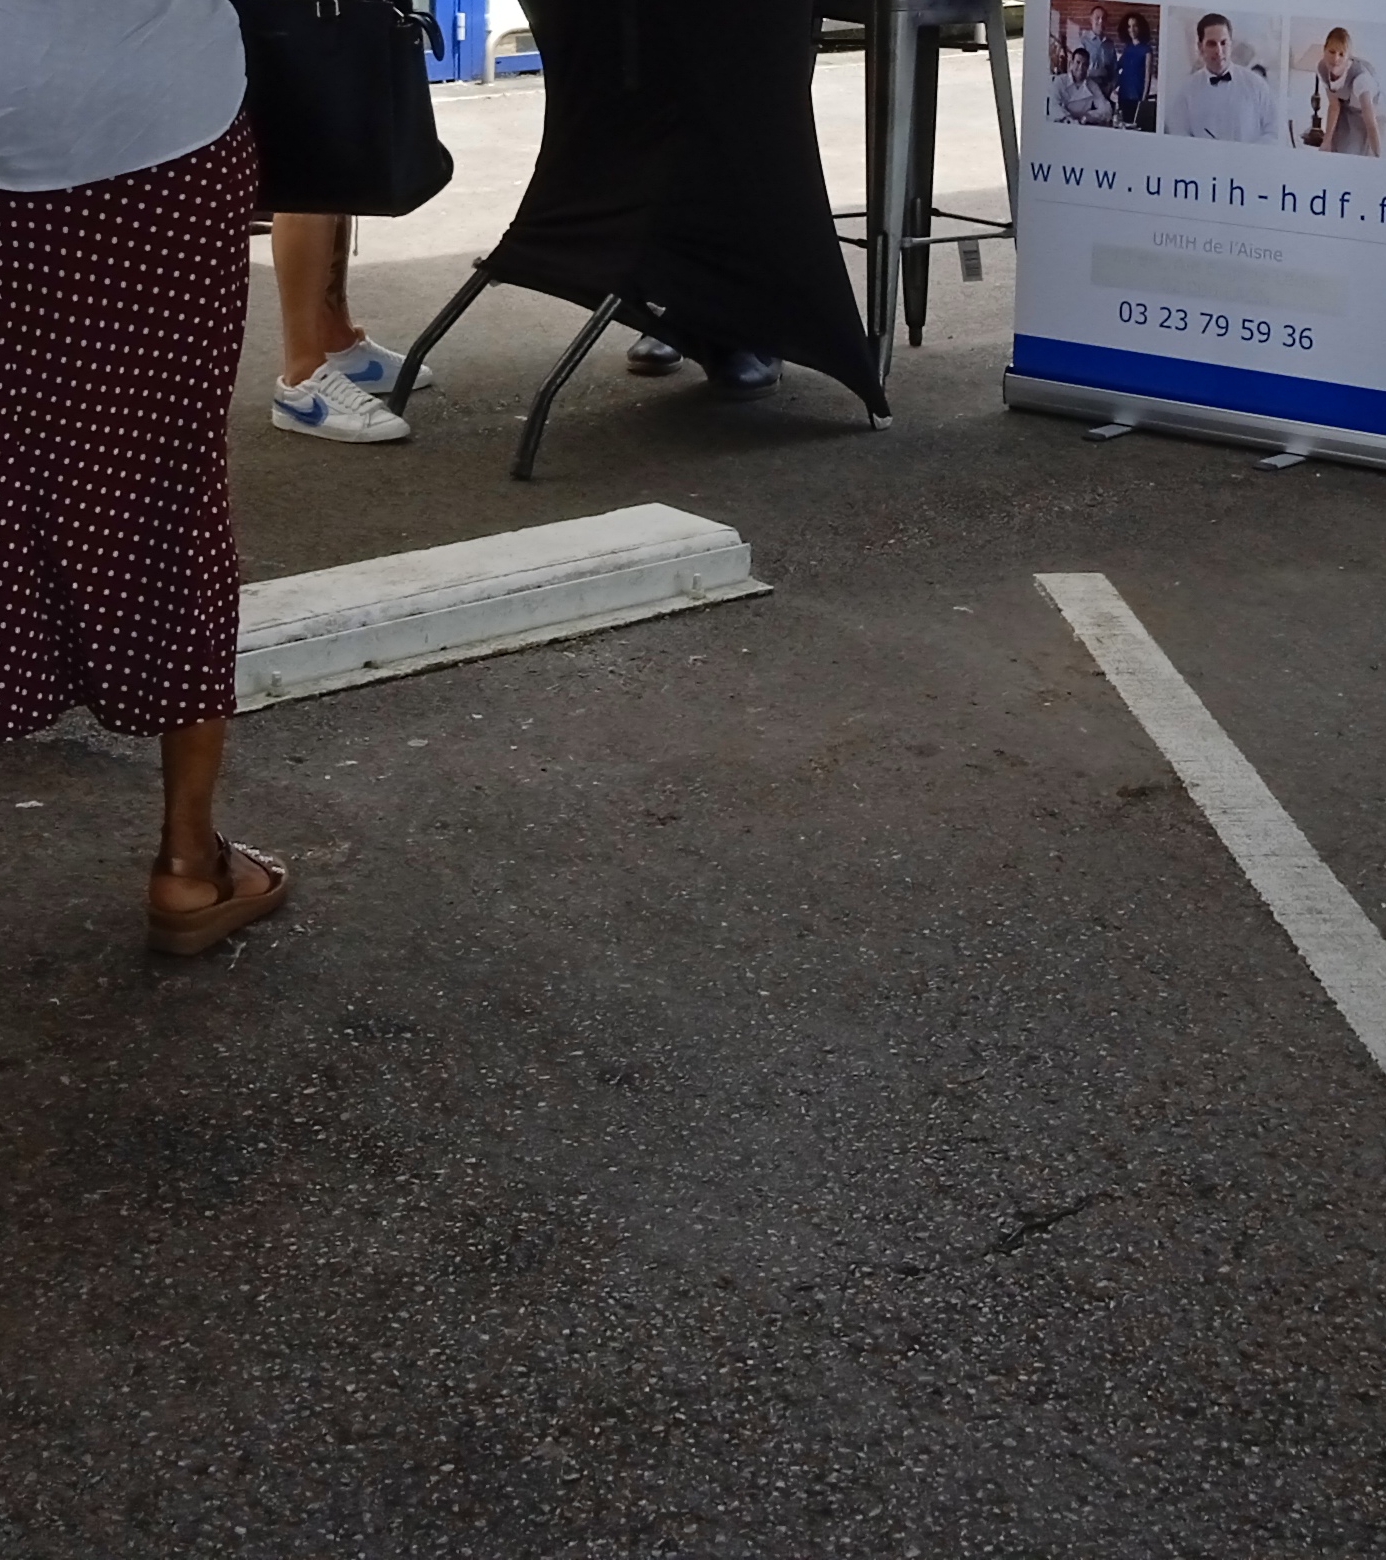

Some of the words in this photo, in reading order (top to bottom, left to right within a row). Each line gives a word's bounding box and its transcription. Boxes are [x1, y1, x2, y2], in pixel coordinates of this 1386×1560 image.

[1152, 232, 1197, 251] UMIH
[1202, 238, 1223, 255] de
[1229, 240, 1284, 263] l'Aisne
[1119, 301, 1149, 326] 03
[1158, 306, 1189, 332] 23
[1199, 312, 1230, 337] 79
[1240, 318, 1271, 343] 59
[1282, 324, 1314, 350] 36
